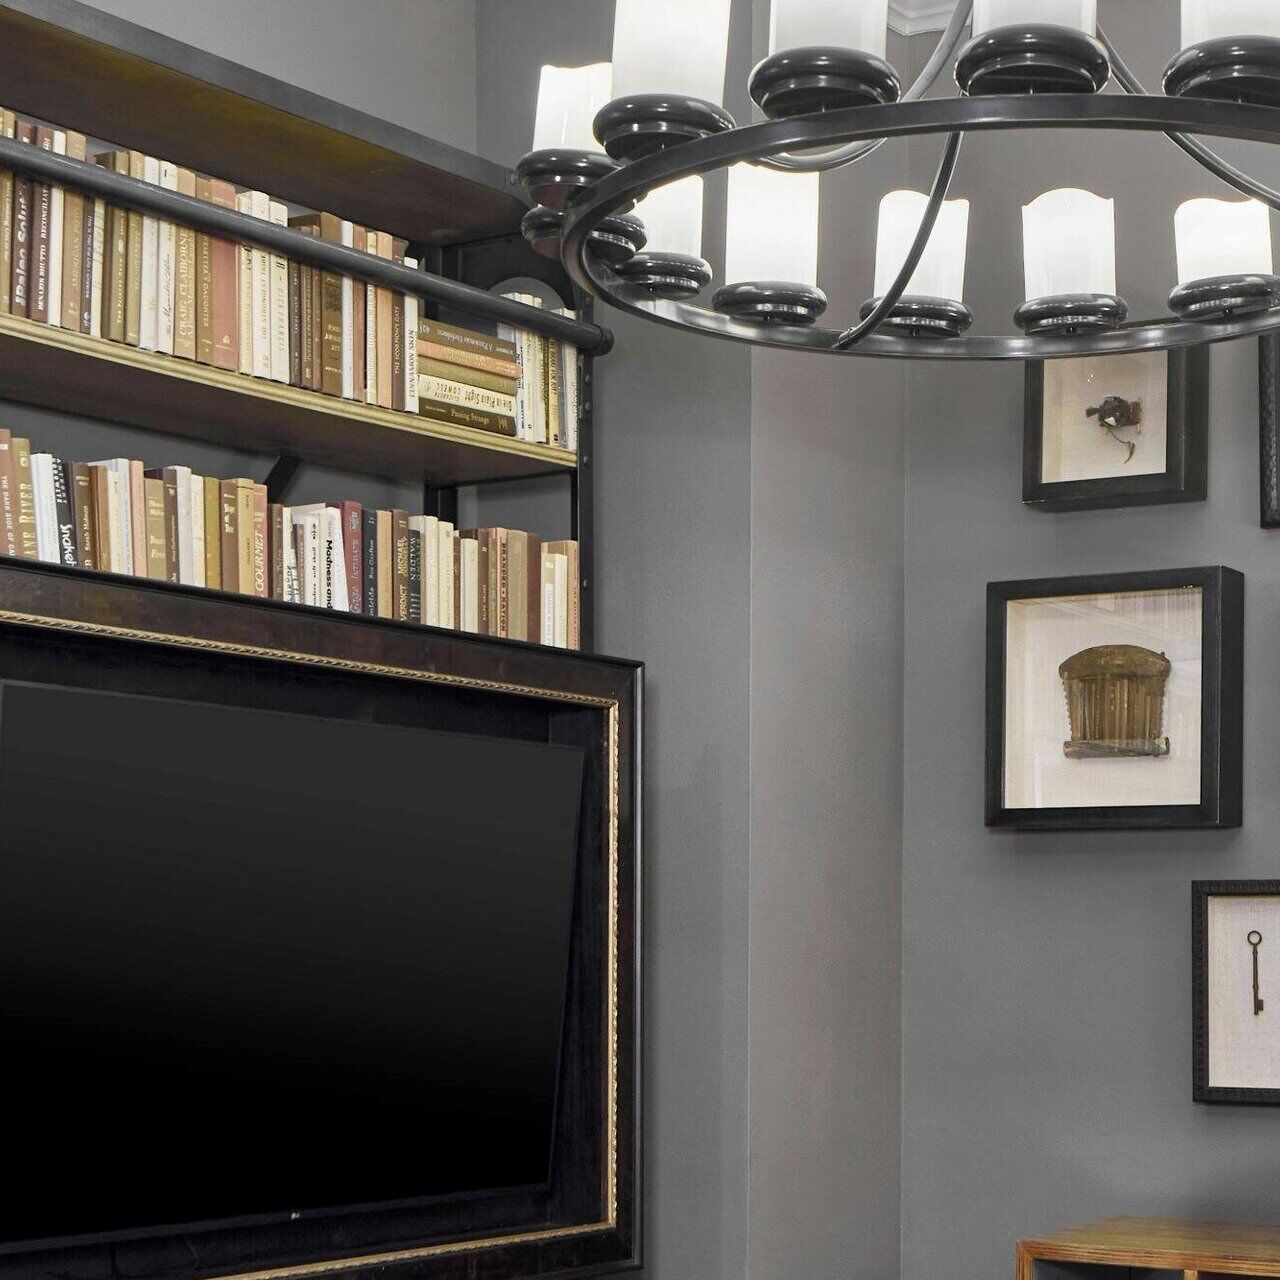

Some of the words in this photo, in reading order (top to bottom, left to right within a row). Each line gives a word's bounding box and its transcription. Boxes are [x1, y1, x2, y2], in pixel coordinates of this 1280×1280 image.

[179, 303, 188, 336] CRAIG
[407, 330, 415, 350] SKIN
[407, 352, 415, 398] CINNAMON
[436, 382, 460, 396] LOWELL
[464, 389, 480, 405] Sight
[480, 394, 496, 408] Plain
[502, 400, 512, 412] Die
[3, 491, 11, 511] DARK
[19, 483, 35, 524] RIVER
[5, 513, 13, 529] SIDE
[23, 532, 37, 556] ANE
[254, 532, 265, 592] GOURMET
[399, 584, 407, 621] VERDICT
